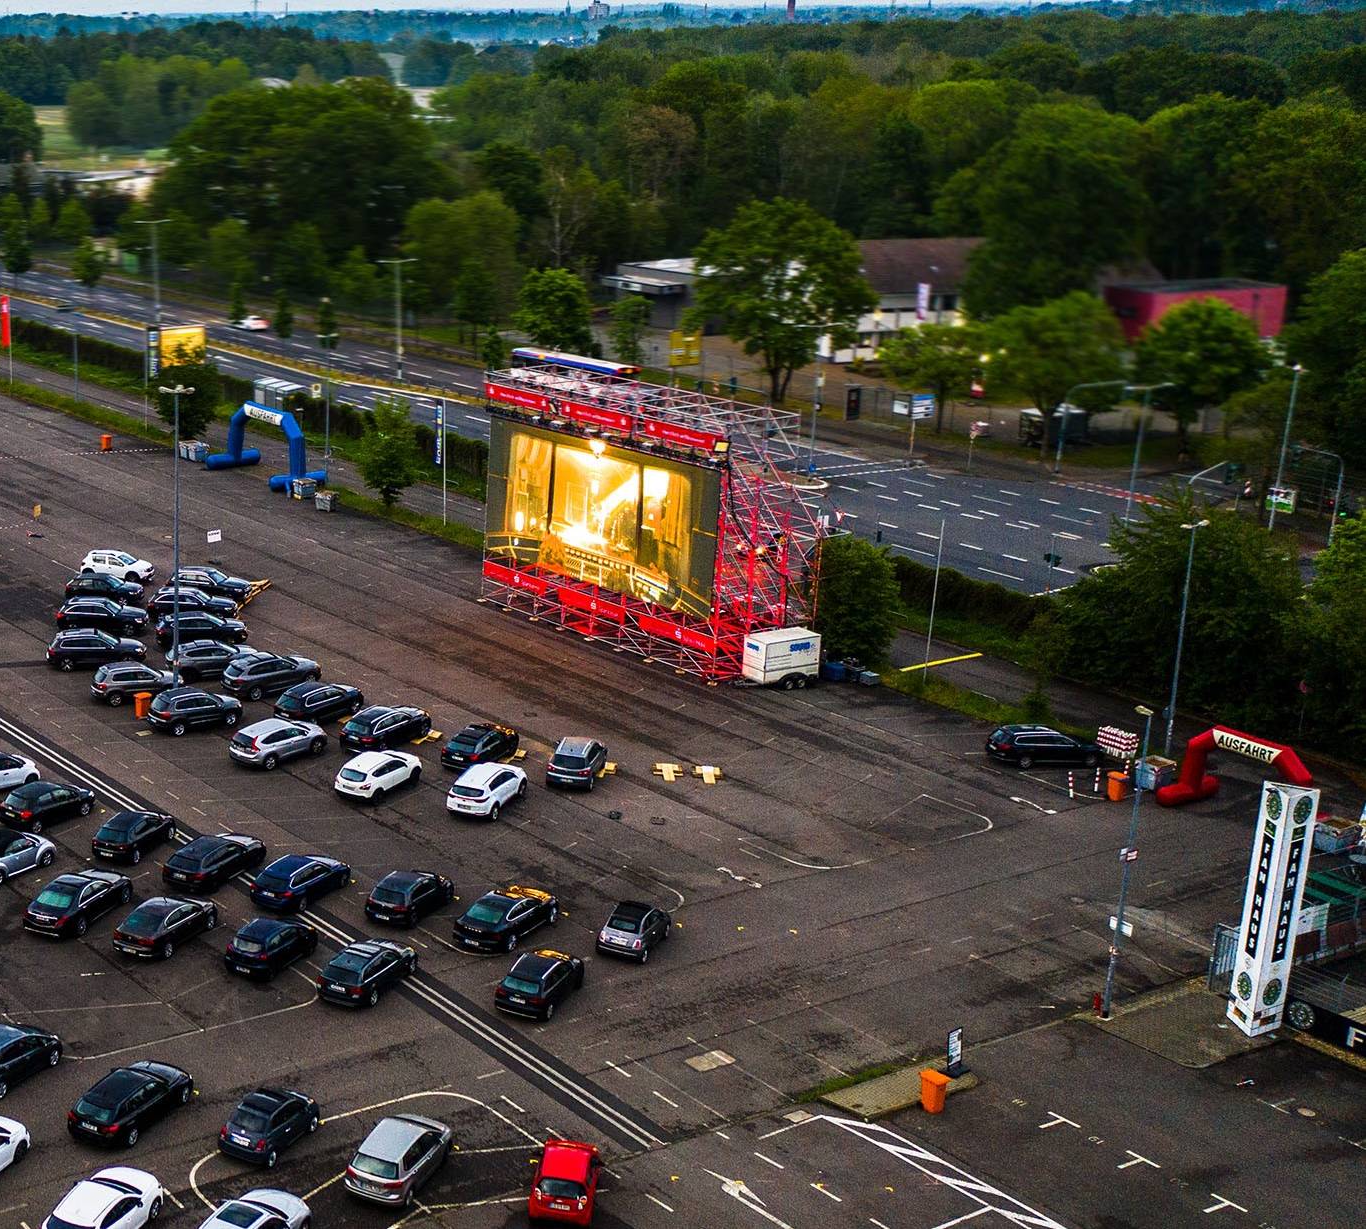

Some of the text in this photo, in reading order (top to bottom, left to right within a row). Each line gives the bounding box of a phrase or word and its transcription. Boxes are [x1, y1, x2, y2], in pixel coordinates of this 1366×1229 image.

[1217, 734, 1274, 761] AUSFAHRT
[1248, 842, 1271, 949] FAN HAUS
[1275, 847, 1300, 955] FAN HAUS
